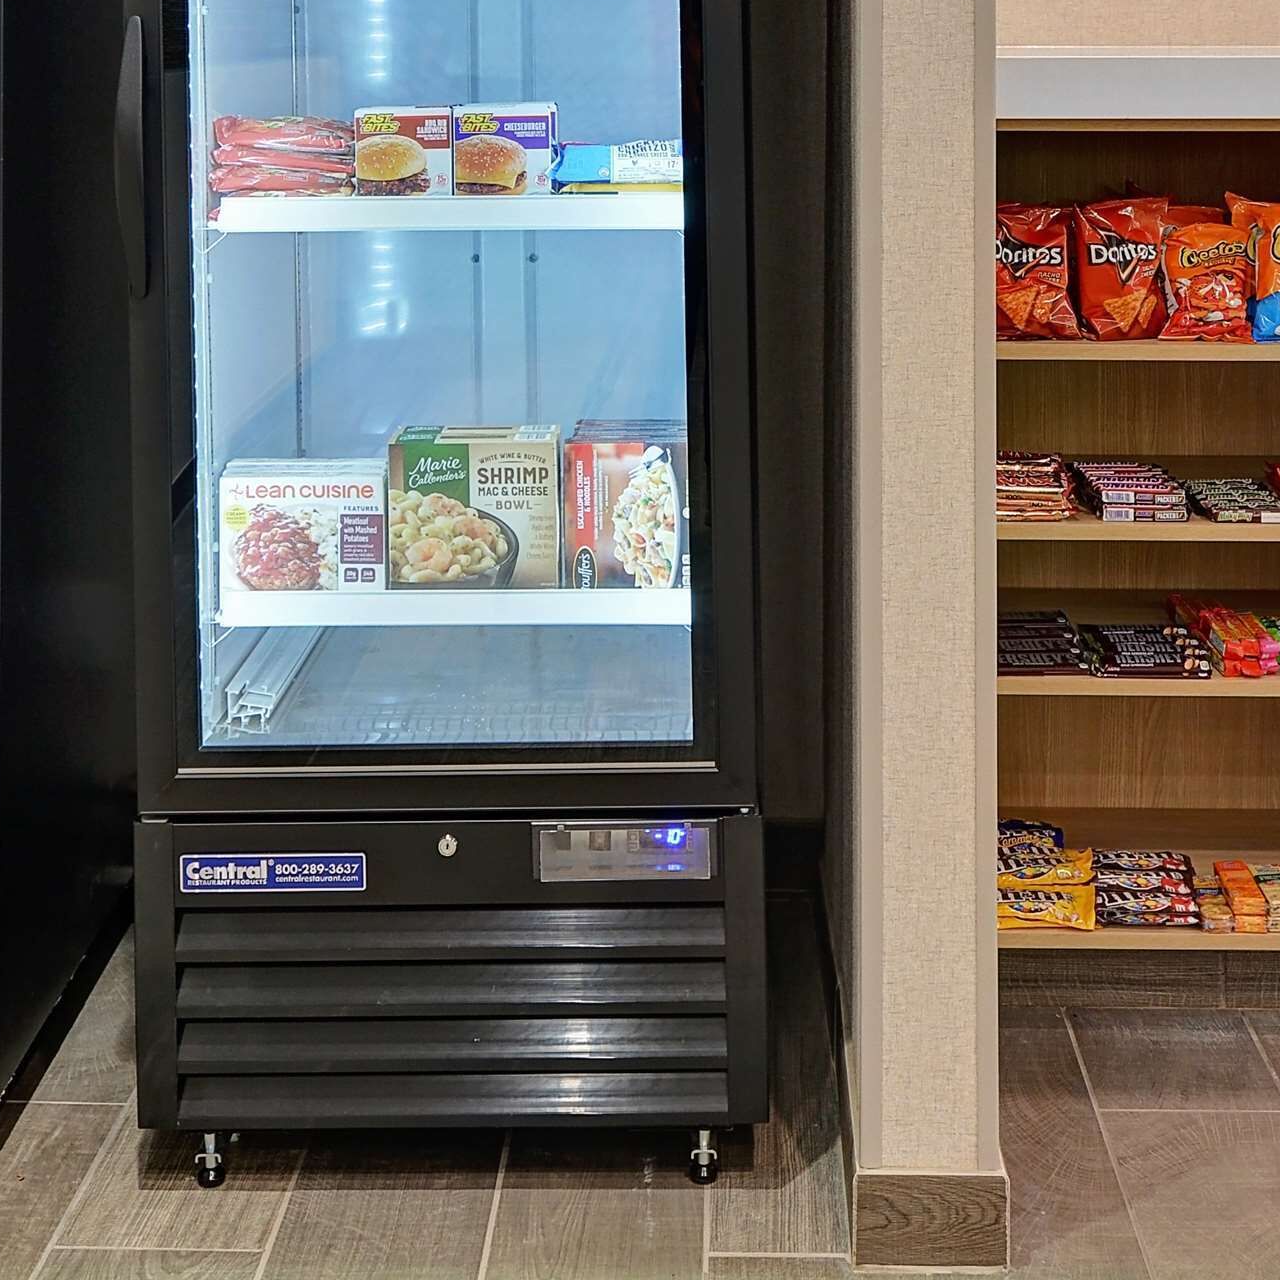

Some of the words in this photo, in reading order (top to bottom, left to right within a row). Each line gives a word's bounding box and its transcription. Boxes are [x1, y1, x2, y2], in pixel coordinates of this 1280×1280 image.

[362, 113, 393, 123] FAST
[462, 113, 492, 123] FAST
[362, 122, 399, 133] BITES
[461, 122, 498, 133] BITES
[996, 240, 1062, 265] Doritos
[1089, 242, 1158, 264] Doritos
[1181, 240, 1245, 267] Cheetos
[479, 454, 498, 464] WHITE
[523, 452, 546, 464] BUTTER
[409, 456, 462, 474] Marie
[409, 469, 466, 488] Callender's
[477, 467, 549, 485] SHRIMP
[478, 487, 499, 496] MAC
[501, 486, 509, 496] &
[511, 486, 548, 496] CHEESE
[495, 500, 533, 510] BOWL
[578, 553, 593, 590] ouffer's
[999, 653, 1079, 664] ERSHEY'S
[186, 859, 268, 880] Central
[275, 863, 360, 875] 800-289-3637
[275, 874, 359, 883] centralrestaurant.com
